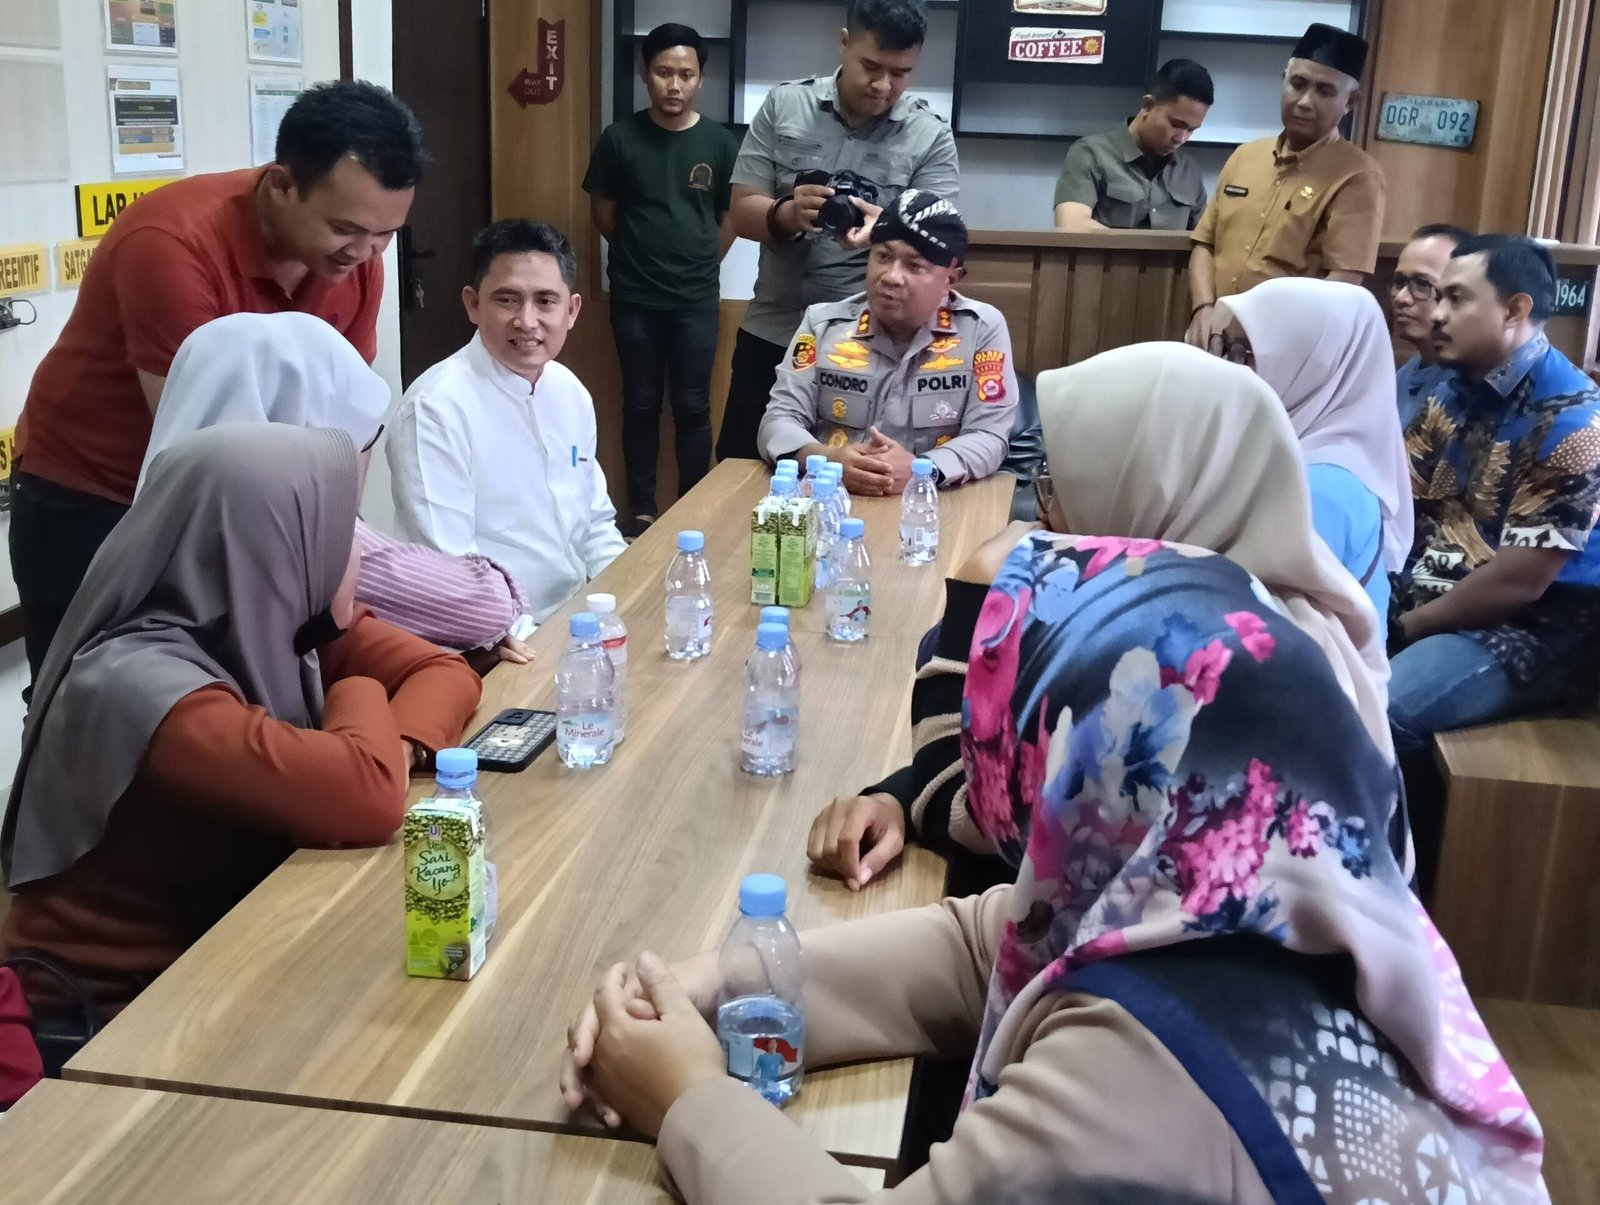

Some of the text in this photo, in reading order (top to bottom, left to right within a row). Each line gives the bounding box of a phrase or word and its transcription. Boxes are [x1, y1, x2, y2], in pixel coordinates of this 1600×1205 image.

[1014, 39, 1082, 58] COFFEE
[545, 29, 558, 91] EXIT
[525, 88, 541, 96] OUT
[1437, 110, 1471, 133] 092
[0, 253, 39, 291] REEMTIF
[64, 247, 97, 281] SATG
[1555, 282, 1587, 307] 1964
[819, 372, 868, 393] CONDRO
[917, 374, 967, 392] POLRI
[564, 727, 605, 738] Minerale
[582, 720, 594, 730] Le
[418, 850, 453, 866] Sari
[410, 863, 461, 882] Kacang
